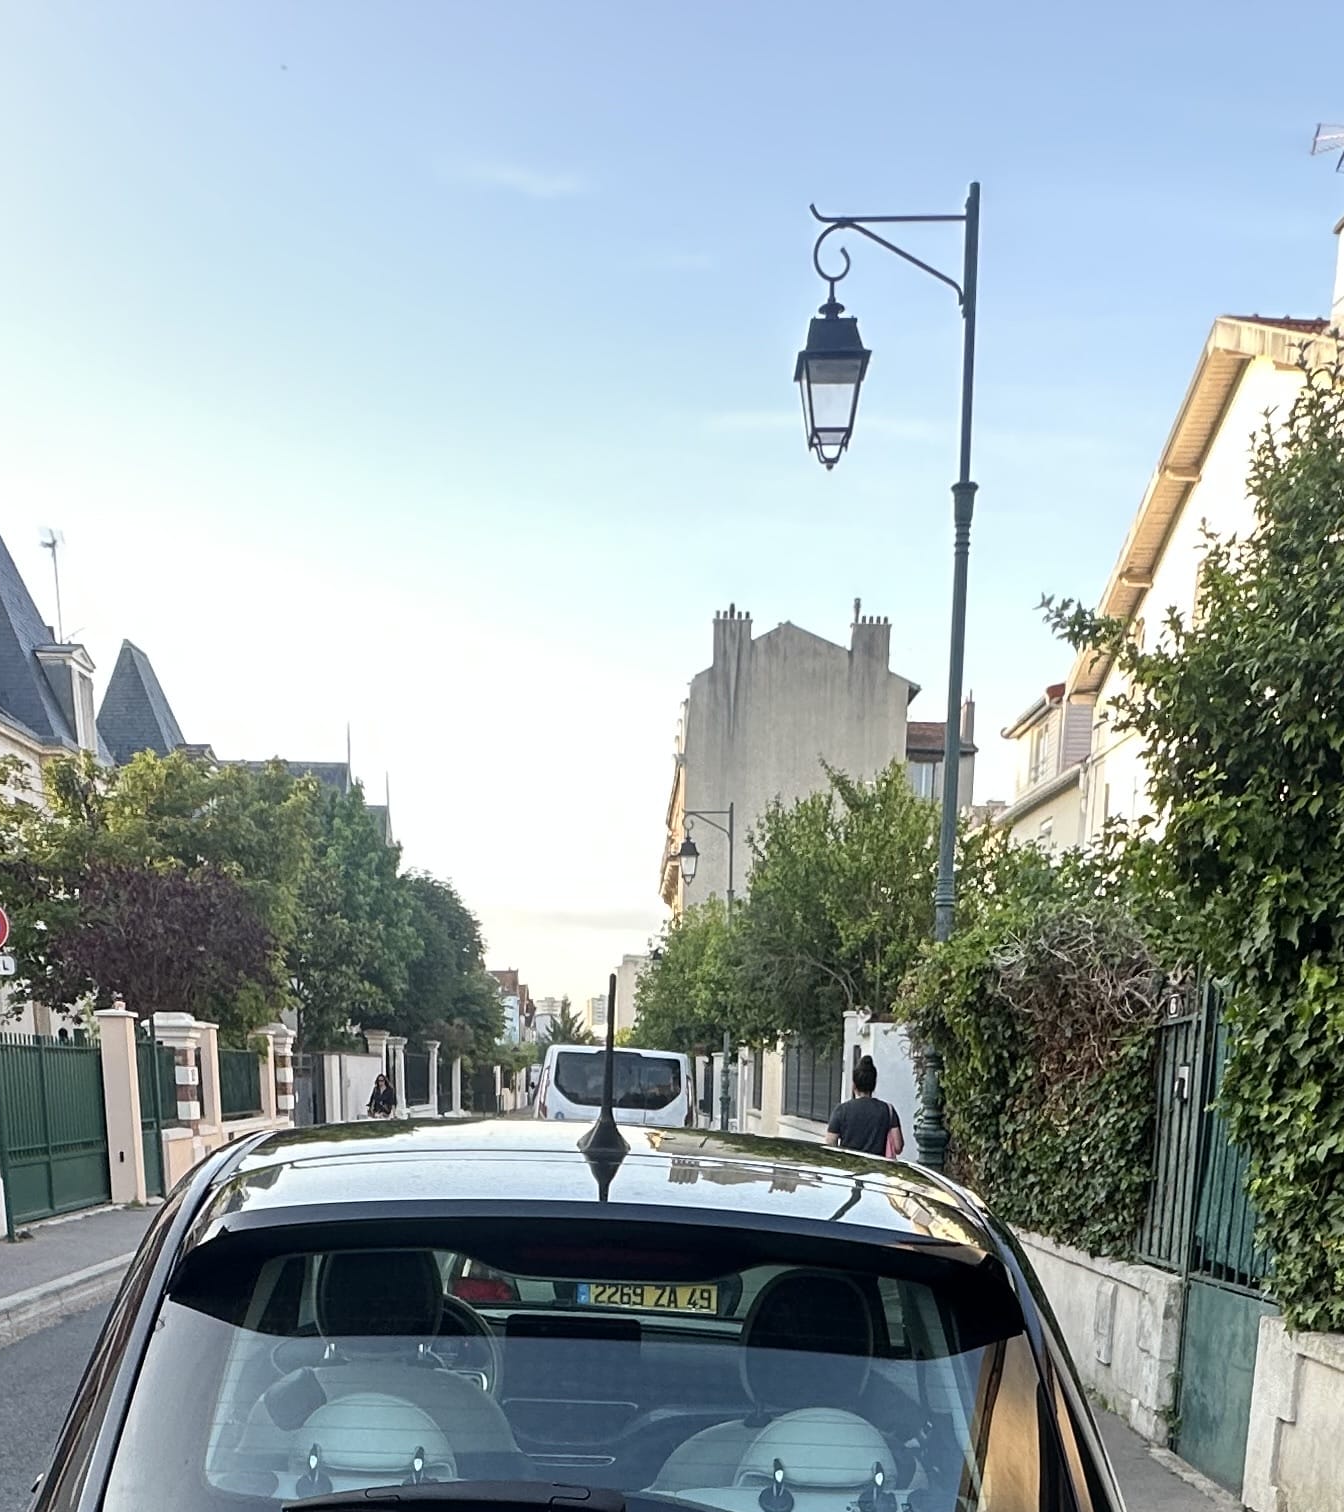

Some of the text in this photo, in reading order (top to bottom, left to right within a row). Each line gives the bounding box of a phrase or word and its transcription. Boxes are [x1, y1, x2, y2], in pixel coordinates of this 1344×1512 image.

[594, 1284, 712, 1310] 2269 ZA 49
